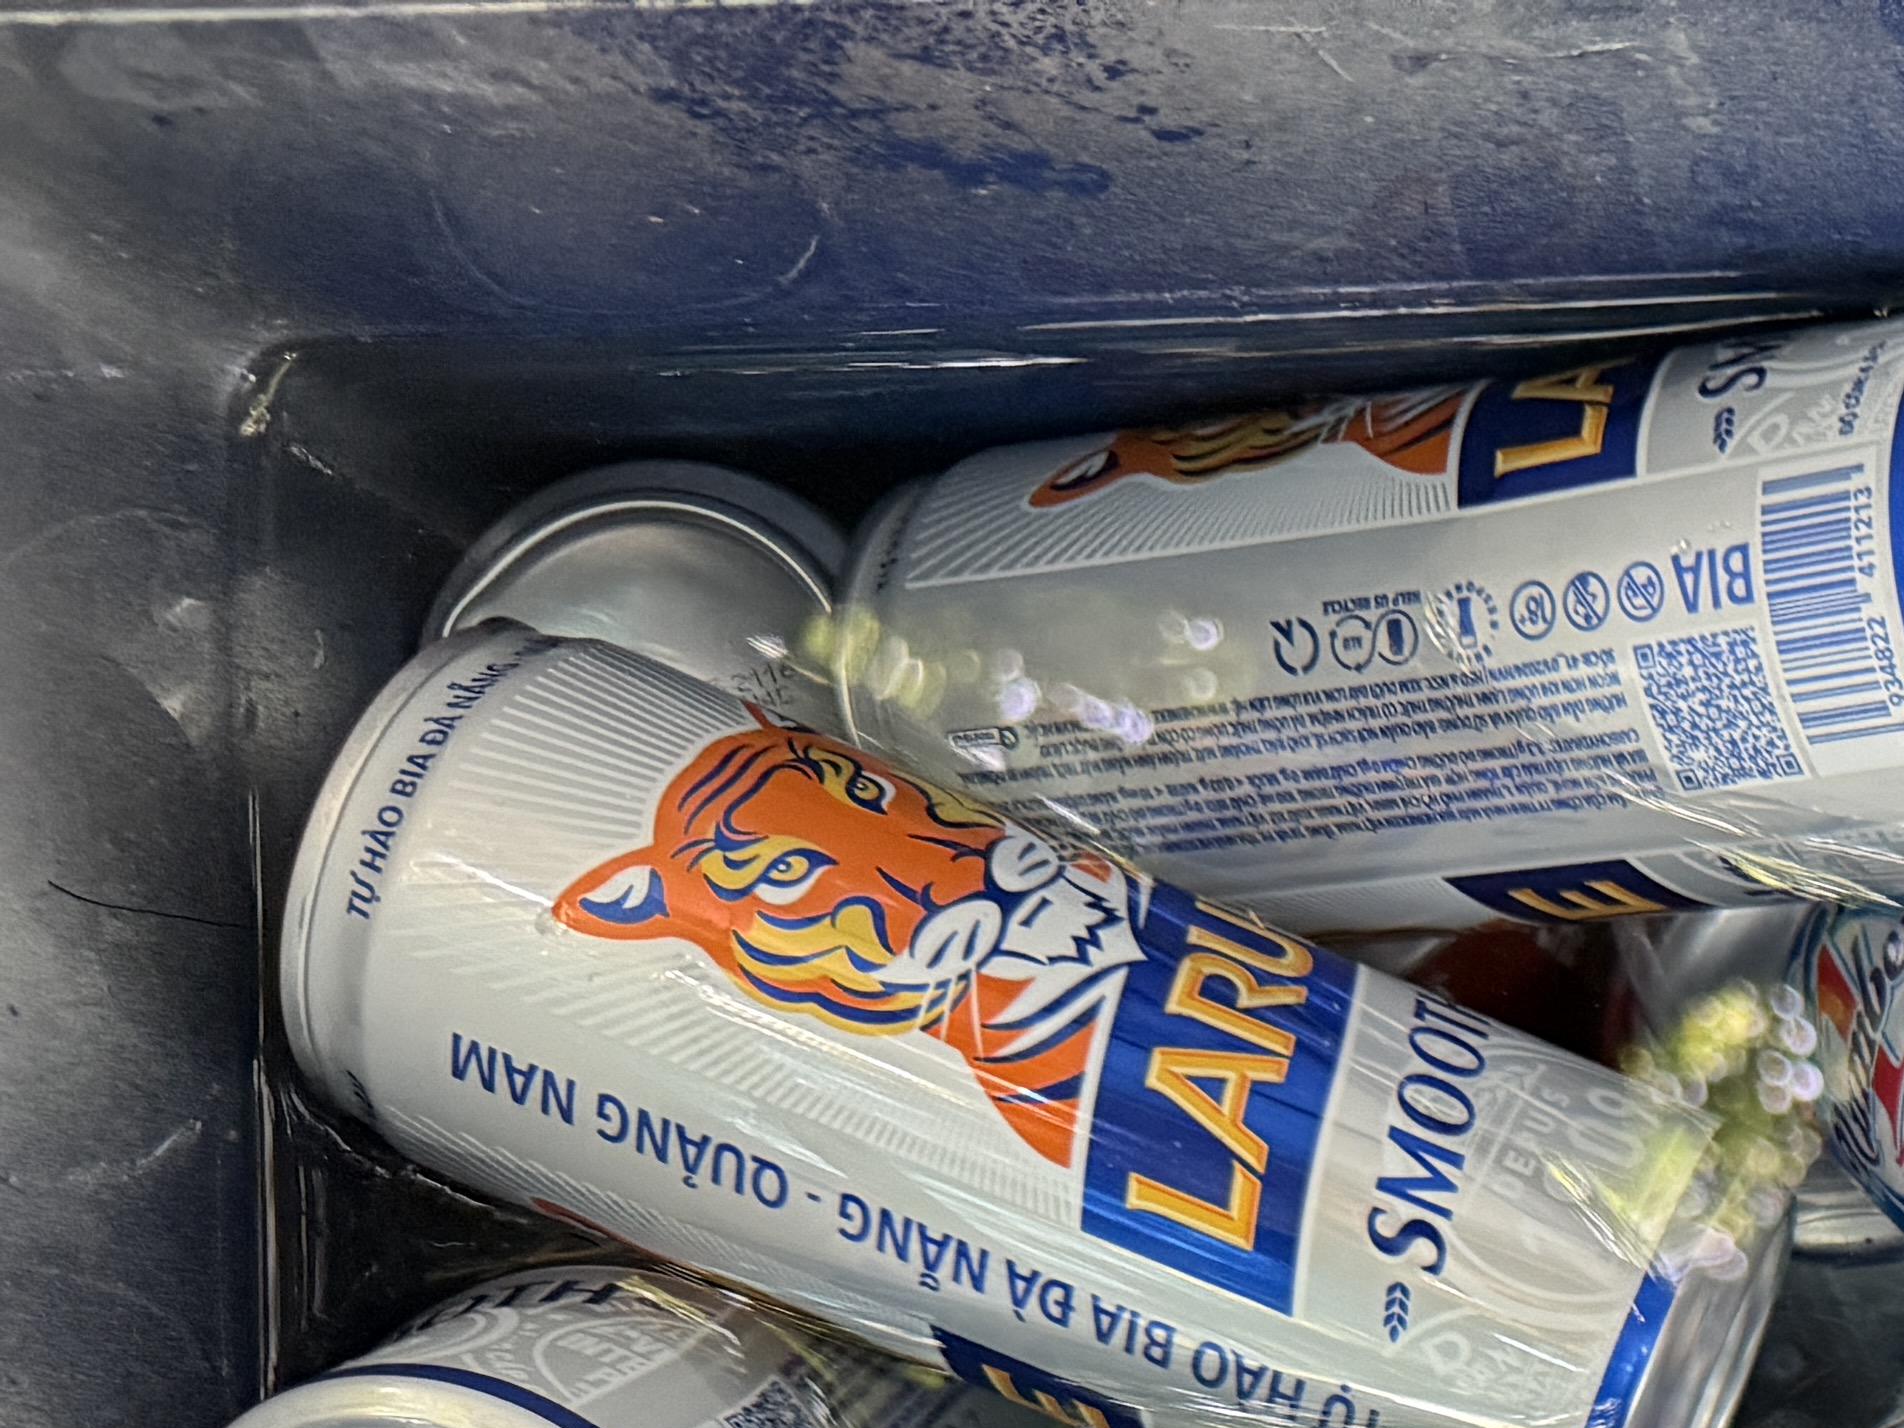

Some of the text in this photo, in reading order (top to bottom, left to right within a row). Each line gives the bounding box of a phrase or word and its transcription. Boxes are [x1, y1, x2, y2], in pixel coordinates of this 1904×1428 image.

[1853, 484, 1875, 578] 411213
[1671, 543, 1754, 614] BIA
[346, 878, 382, 921] TỰ
[365, 805, 405, 877] HÀO
[391, 753, 433, 800] BIA
[418, 711, 464, 754] ĐÀ
[451, 1032, 576, 1125] NAM
[1126, 899, 1315, 1252] LARU
[596, 1092, 790, 1211] QUẢNG
[1366, 992, 1490, 1276] SMOOT
[836, 1193, 990, 1293] NẴNG
[1003, 1258, 1076, 1328] ĐÀ
[1092, 1293, 1176, 1370] BIA
[1191, 1338, 1300, 1427] HÀO
